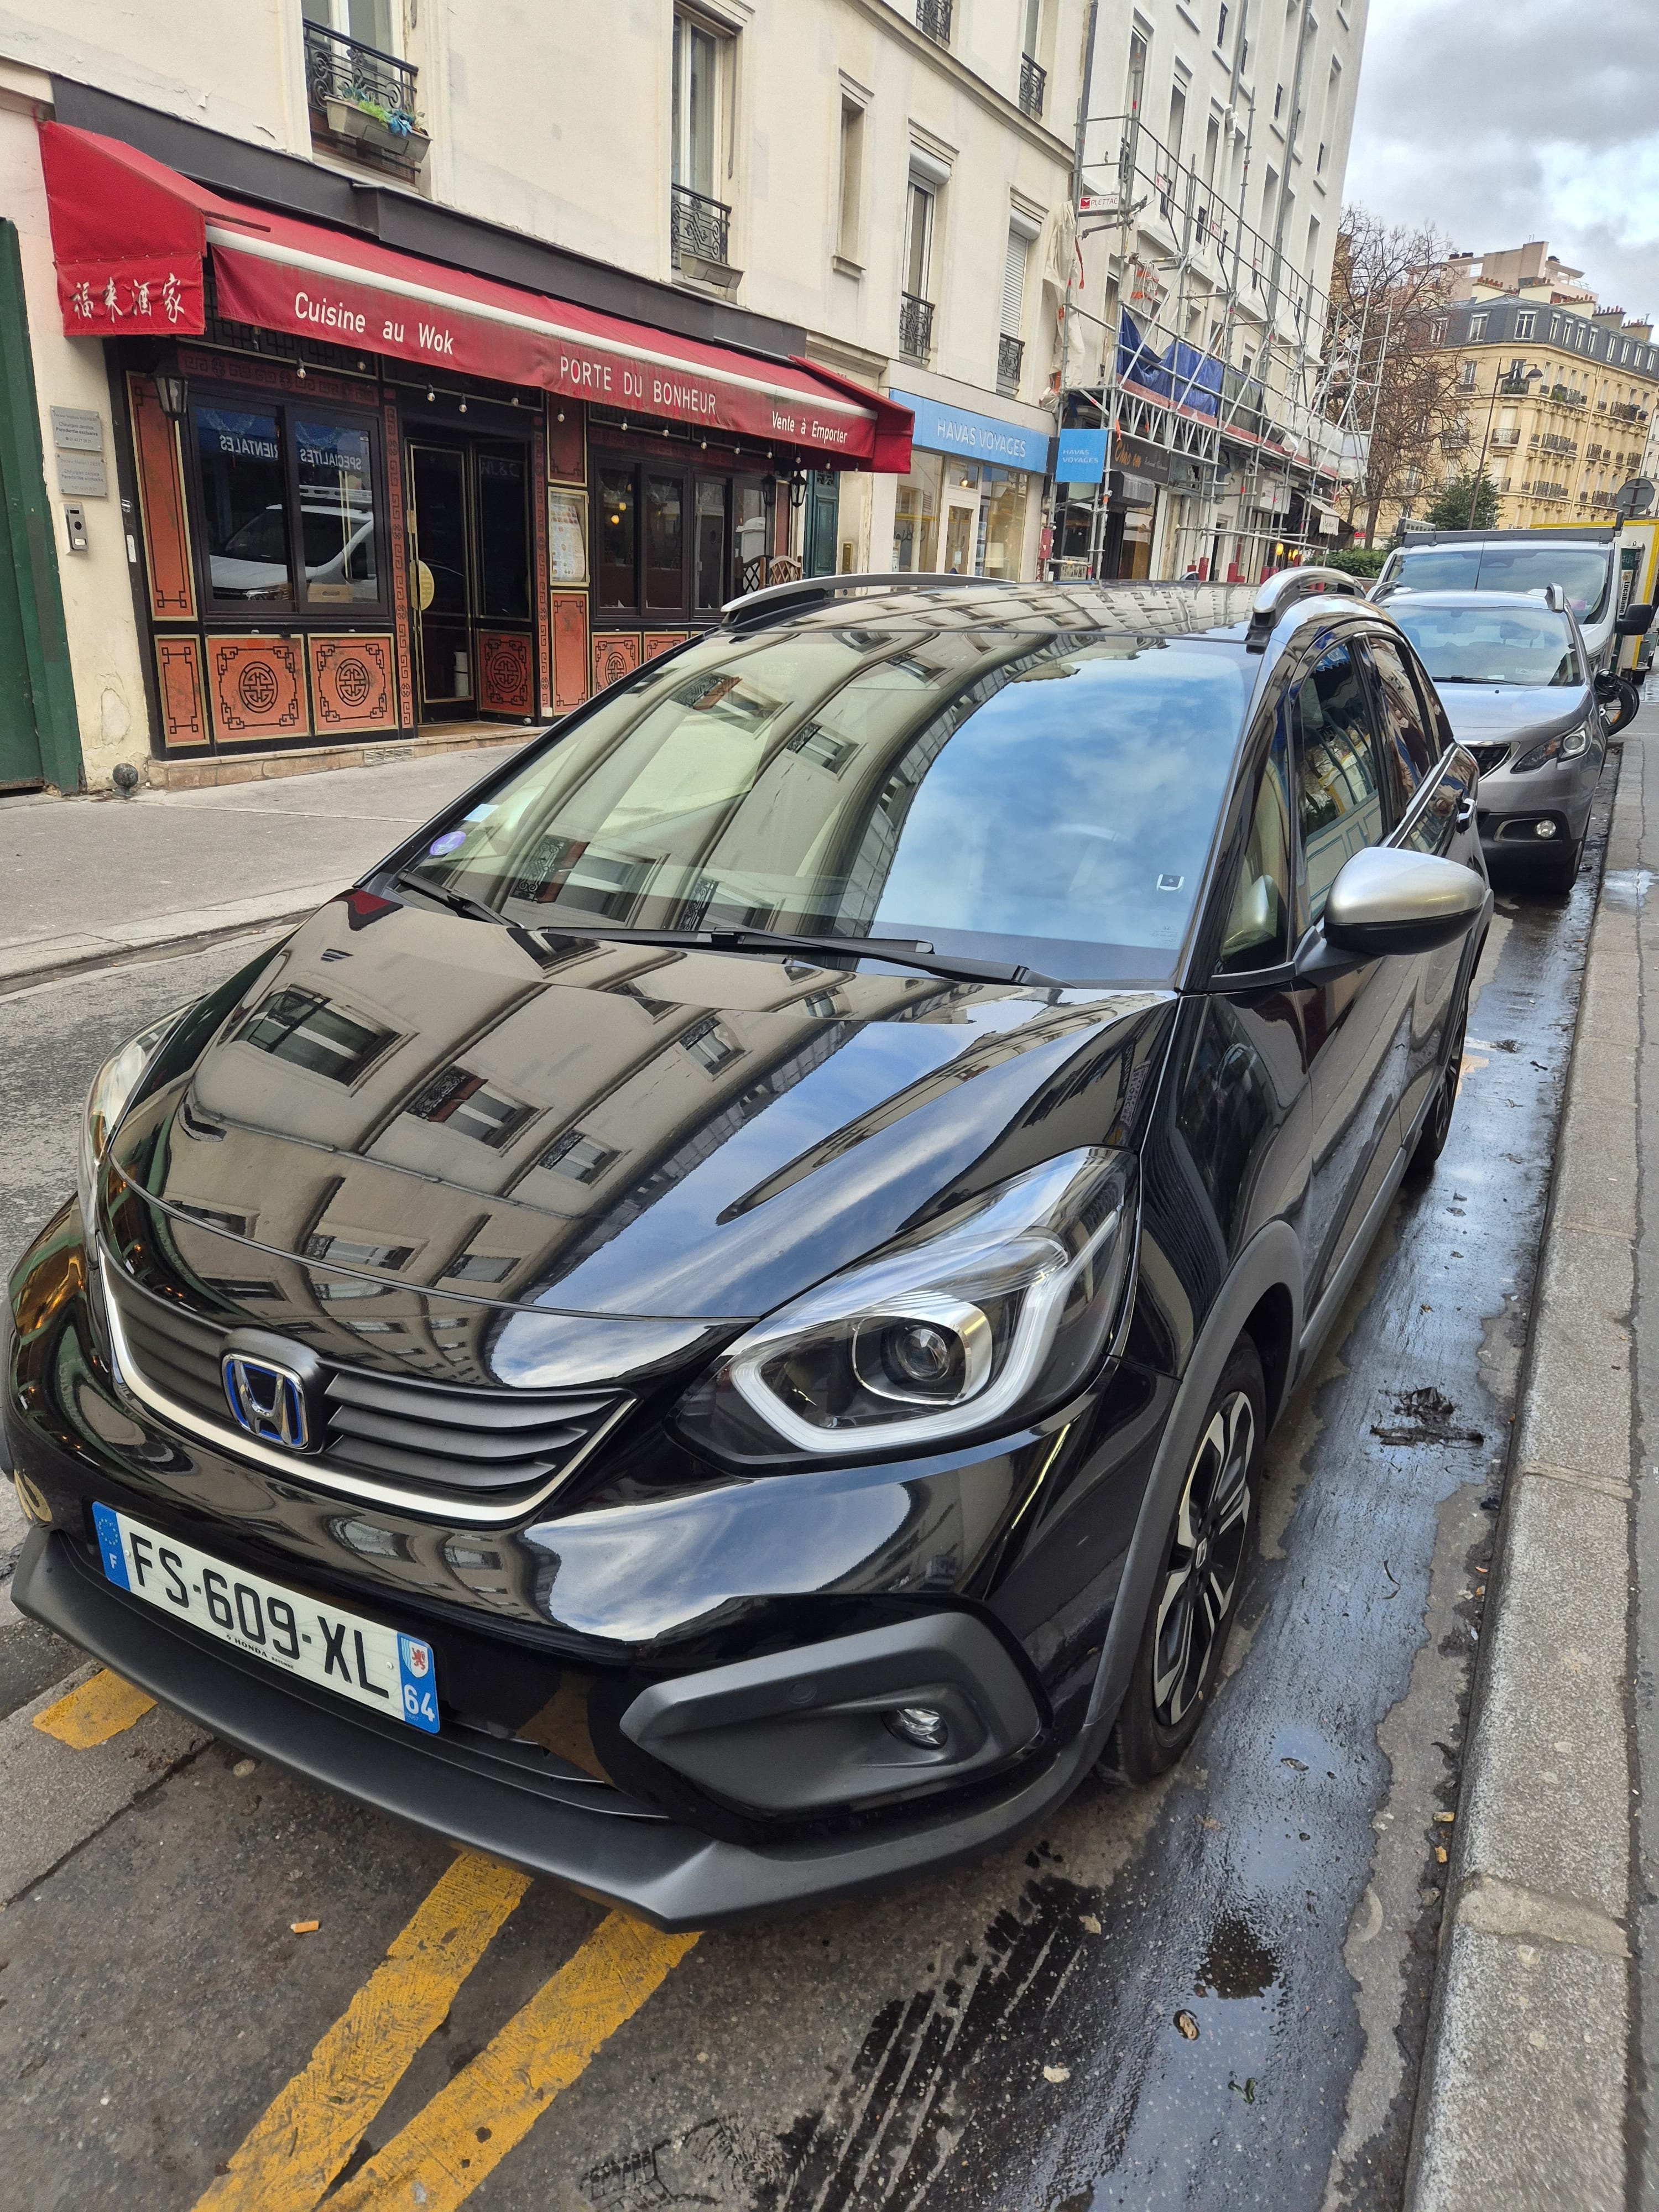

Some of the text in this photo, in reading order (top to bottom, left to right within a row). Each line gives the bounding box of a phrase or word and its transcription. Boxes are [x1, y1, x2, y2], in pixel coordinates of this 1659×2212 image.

[1091, 197, 1118, 206] PLETTAC
[295, 291, 454, 354] Cuisine au Wok
[560, 355, 716, 414] PORTE DU BONHEUR
[773, 410, 848, 444] Vente à Emporter
[937, 418, 1026, 458] HAVAS VOYAGES
[109, 1553, 117, 1569] F
[129, 1532, 389, 1699] FS-609-XL
[234, 1637, 268, 1658] HONDA
[404, 1684, 435, 1722] 64
